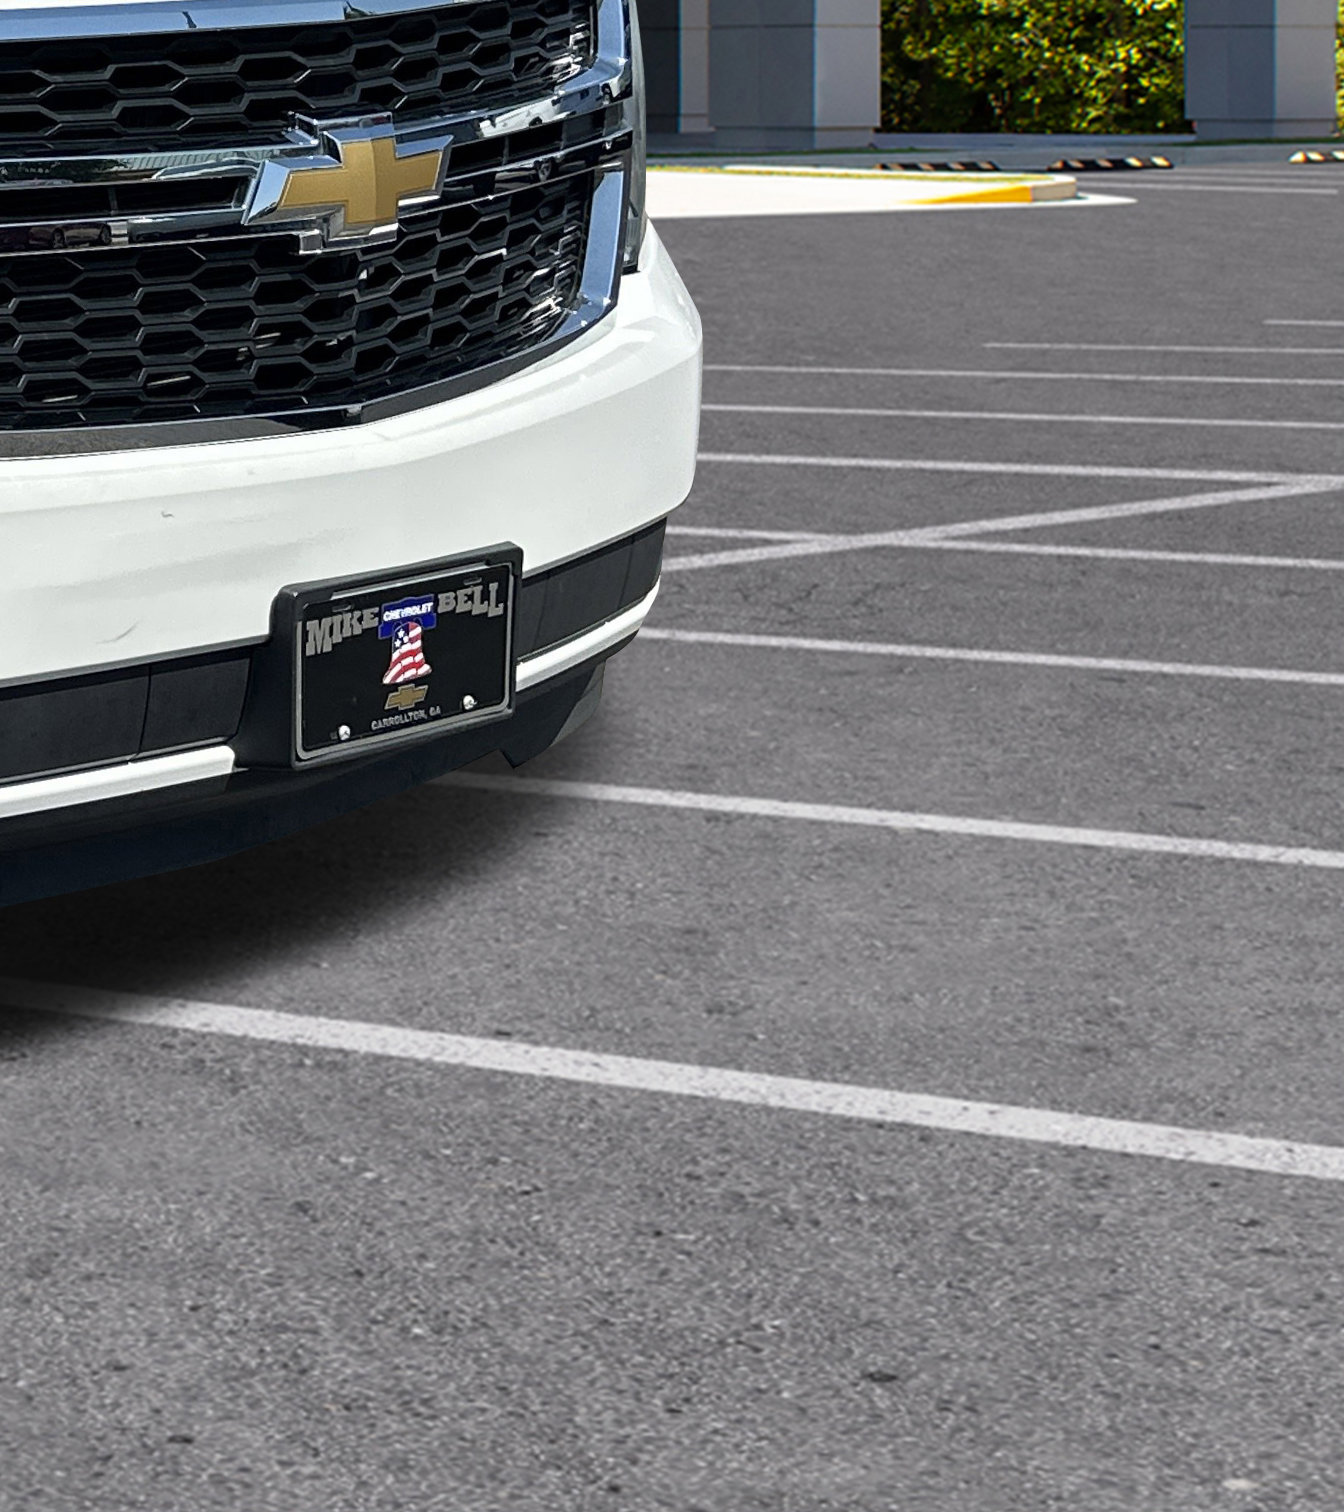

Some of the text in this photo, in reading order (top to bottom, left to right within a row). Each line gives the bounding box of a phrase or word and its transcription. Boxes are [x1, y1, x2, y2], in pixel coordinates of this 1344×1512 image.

[306, 582, 504, 656] MIKE BELL
[383, 602, 434, 622] CHEVROLET
